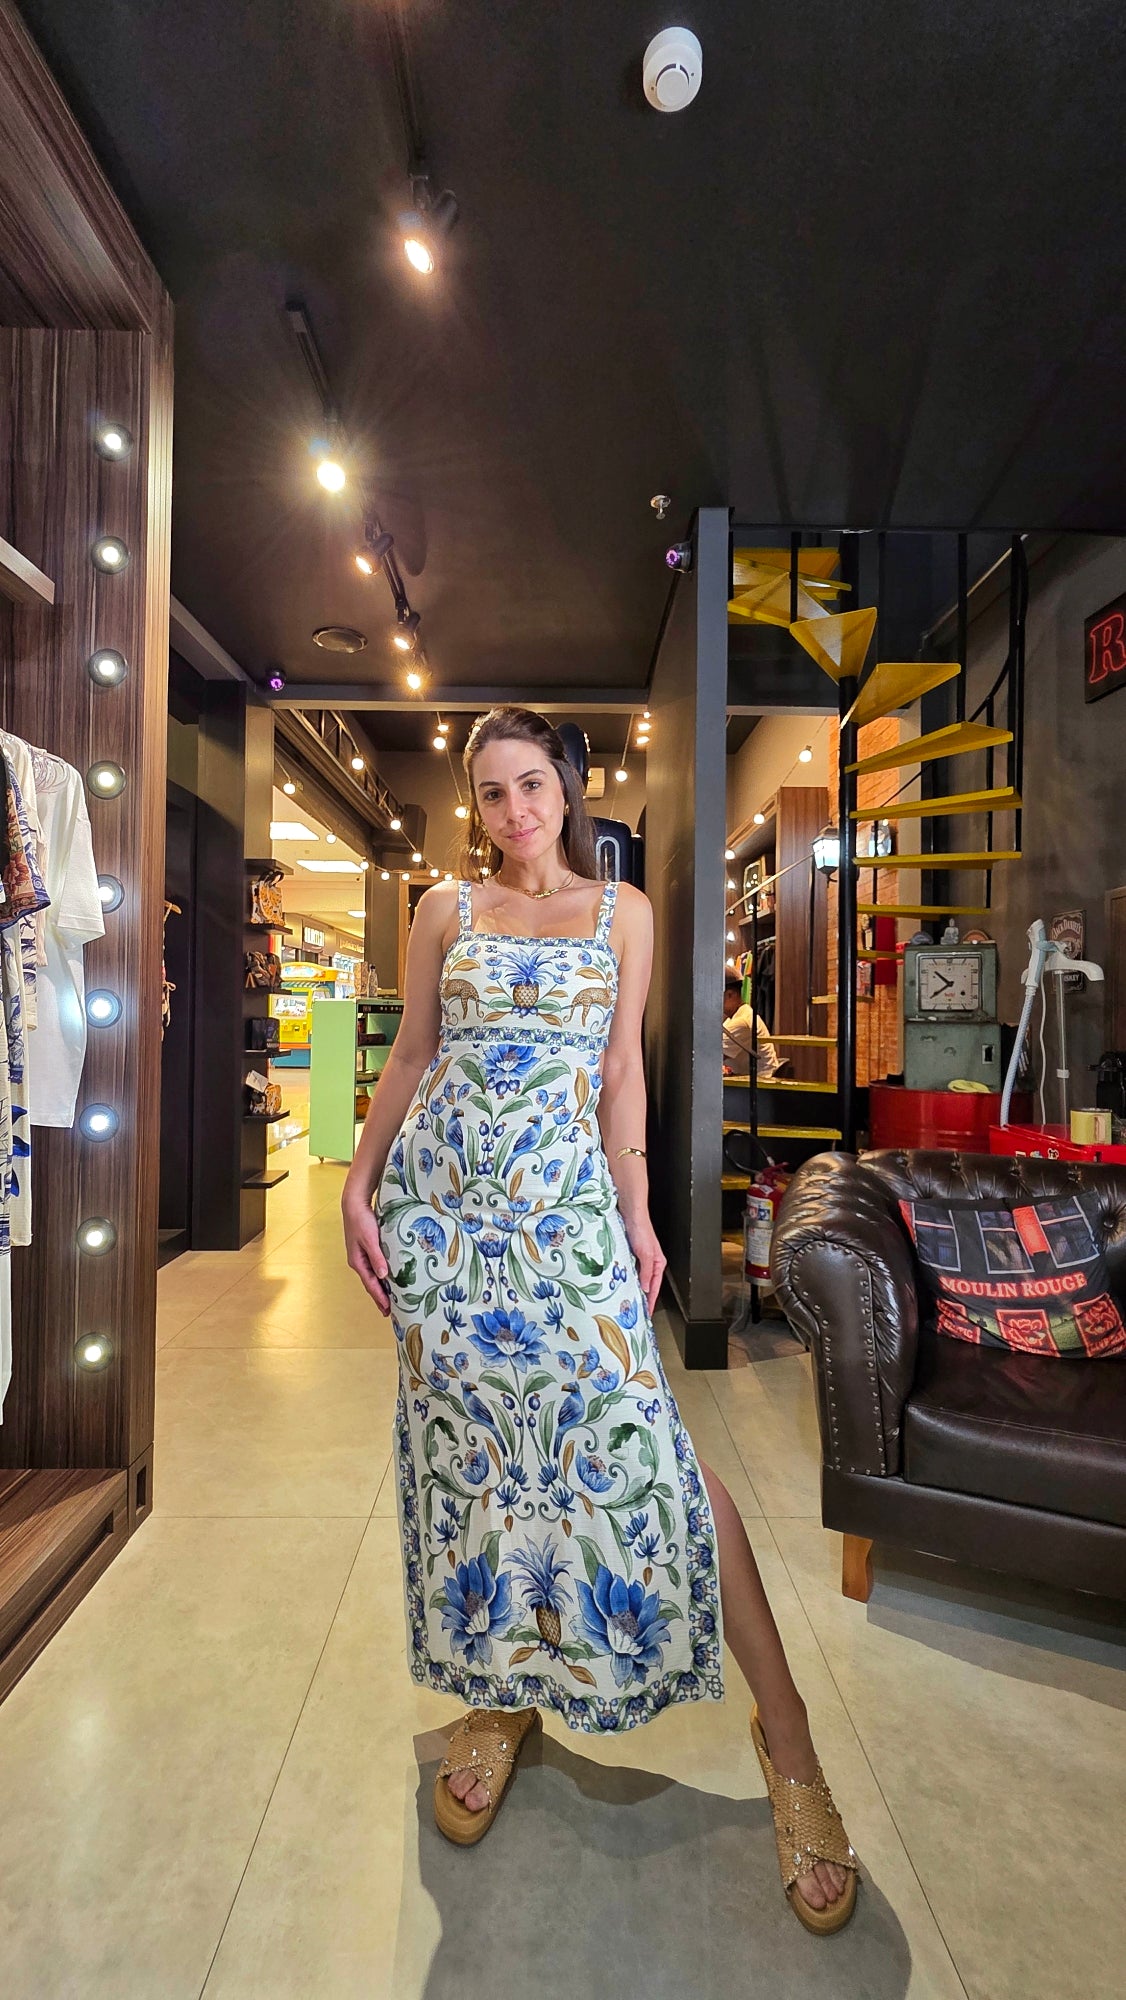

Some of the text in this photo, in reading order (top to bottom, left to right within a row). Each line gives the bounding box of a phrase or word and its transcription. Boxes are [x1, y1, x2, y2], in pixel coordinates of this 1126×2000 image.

[1052, 924, 1064, 940] JACK
[940, 1272, 1087, 1298] MOULIN ROUGE
